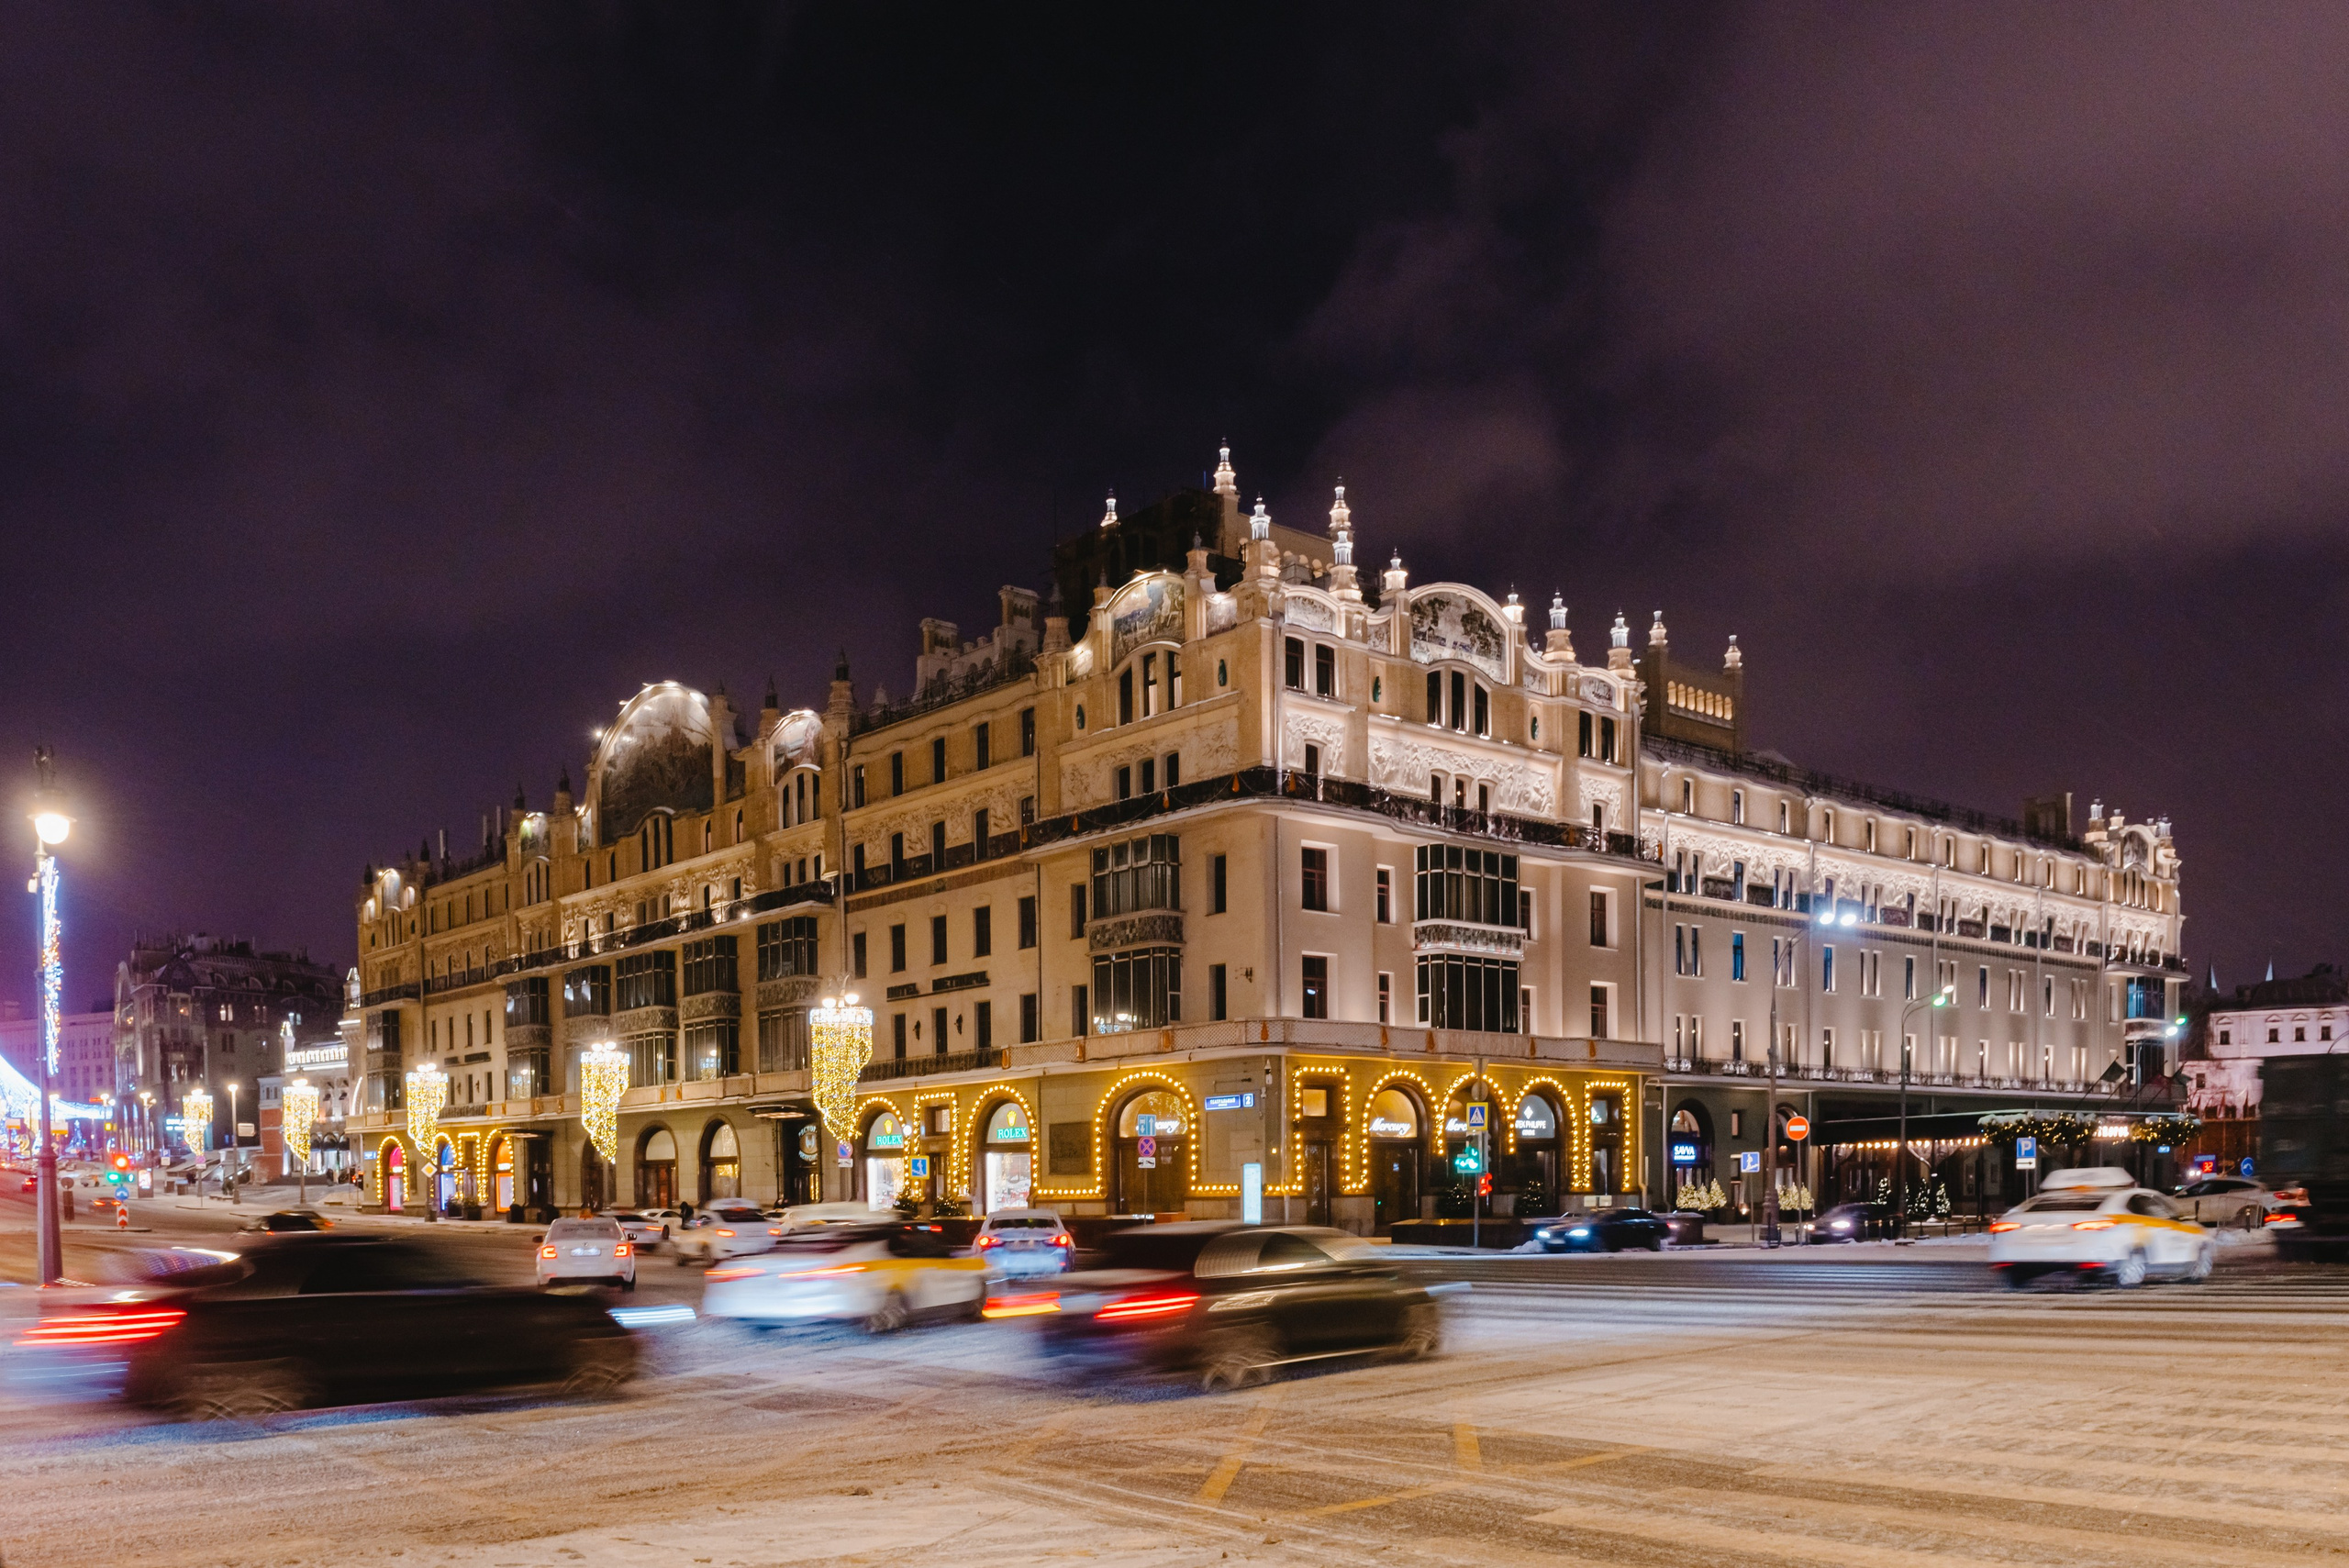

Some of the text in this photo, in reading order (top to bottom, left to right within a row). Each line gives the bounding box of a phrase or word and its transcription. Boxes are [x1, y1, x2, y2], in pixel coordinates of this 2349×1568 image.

[1245, 1095, 1252, 1106] 2
[1368, 1118, 1411, 1136] Mercury
[1445, 1118, 1467, 1131] Merc
[876, 1134, 903, 1146] ROLEX
[996, 1127, 1028, 1140] ROLEX
[1674, 1145, 1695, 1155] SAVVA
[2021, 1140, 2032, 1156] P
